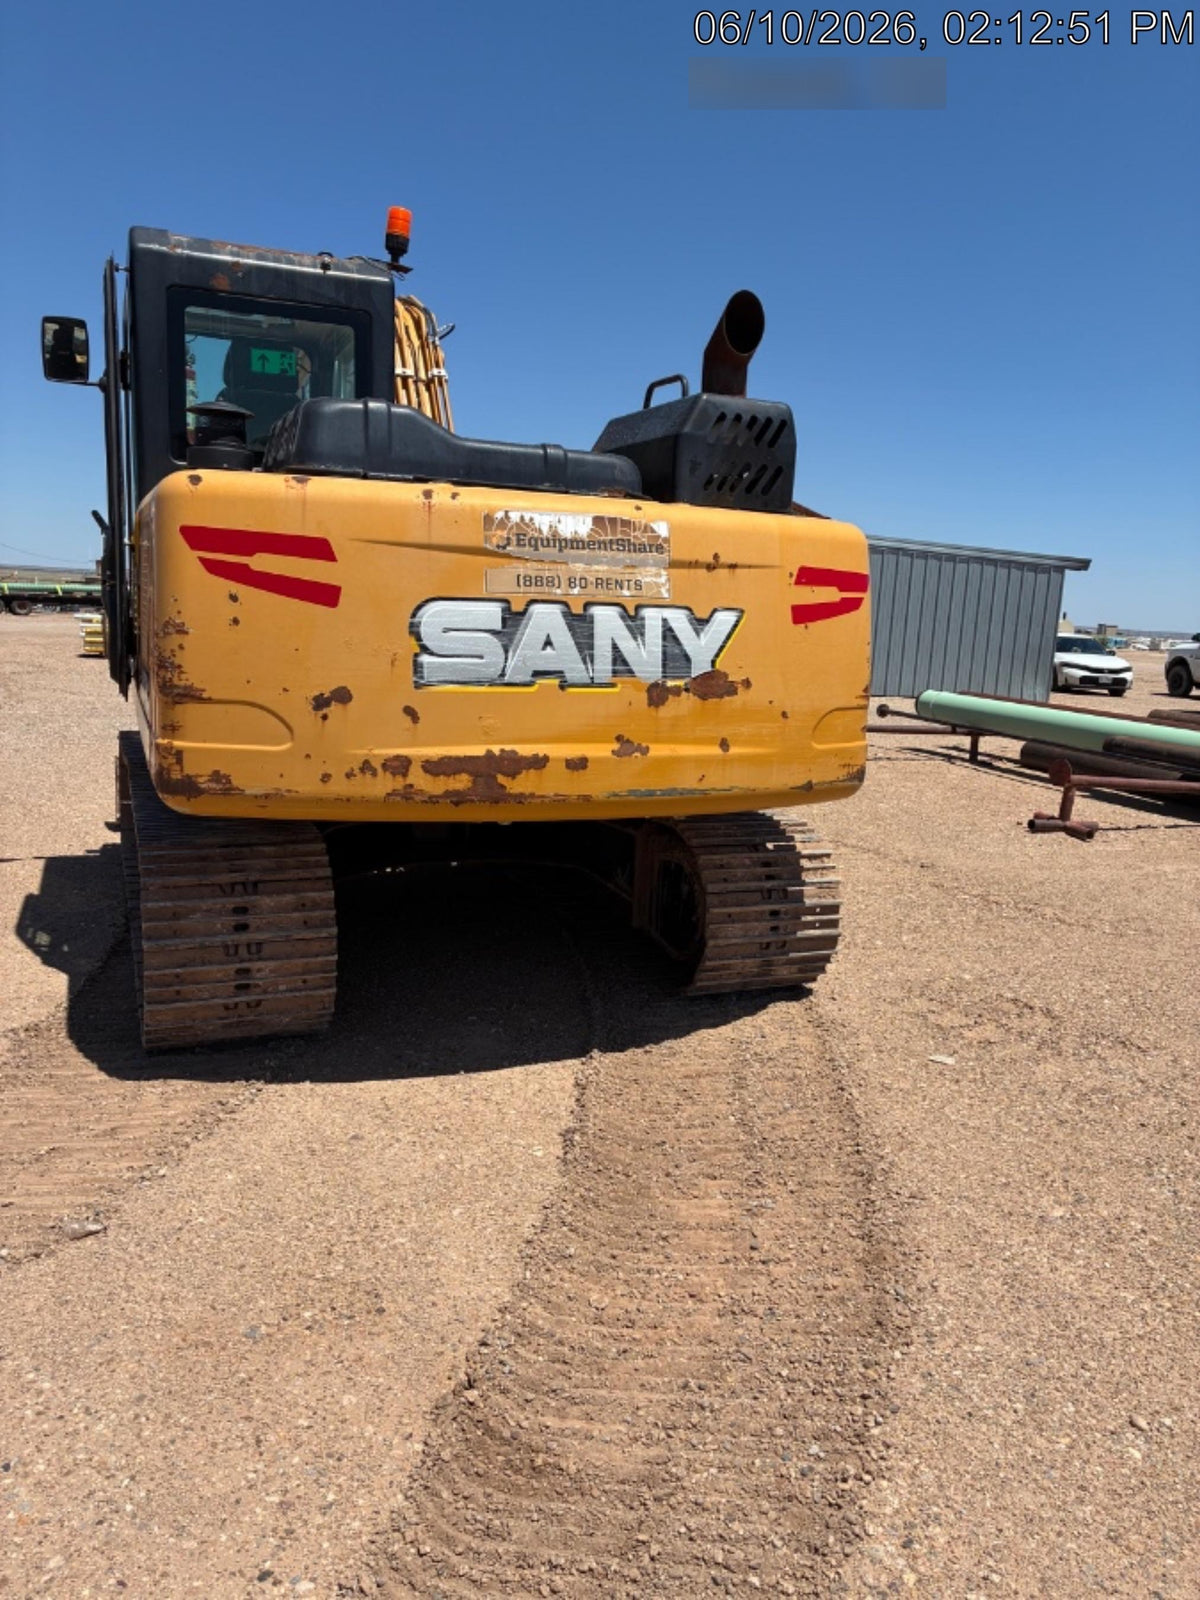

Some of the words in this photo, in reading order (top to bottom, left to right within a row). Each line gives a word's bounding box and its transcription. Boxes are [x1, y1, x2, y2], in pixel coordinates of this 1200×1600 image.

[514, 532, 665, 555] EquipmentShare
[516, 574, 562, 588] (888)
[411, 597, 745, 691] SANY
